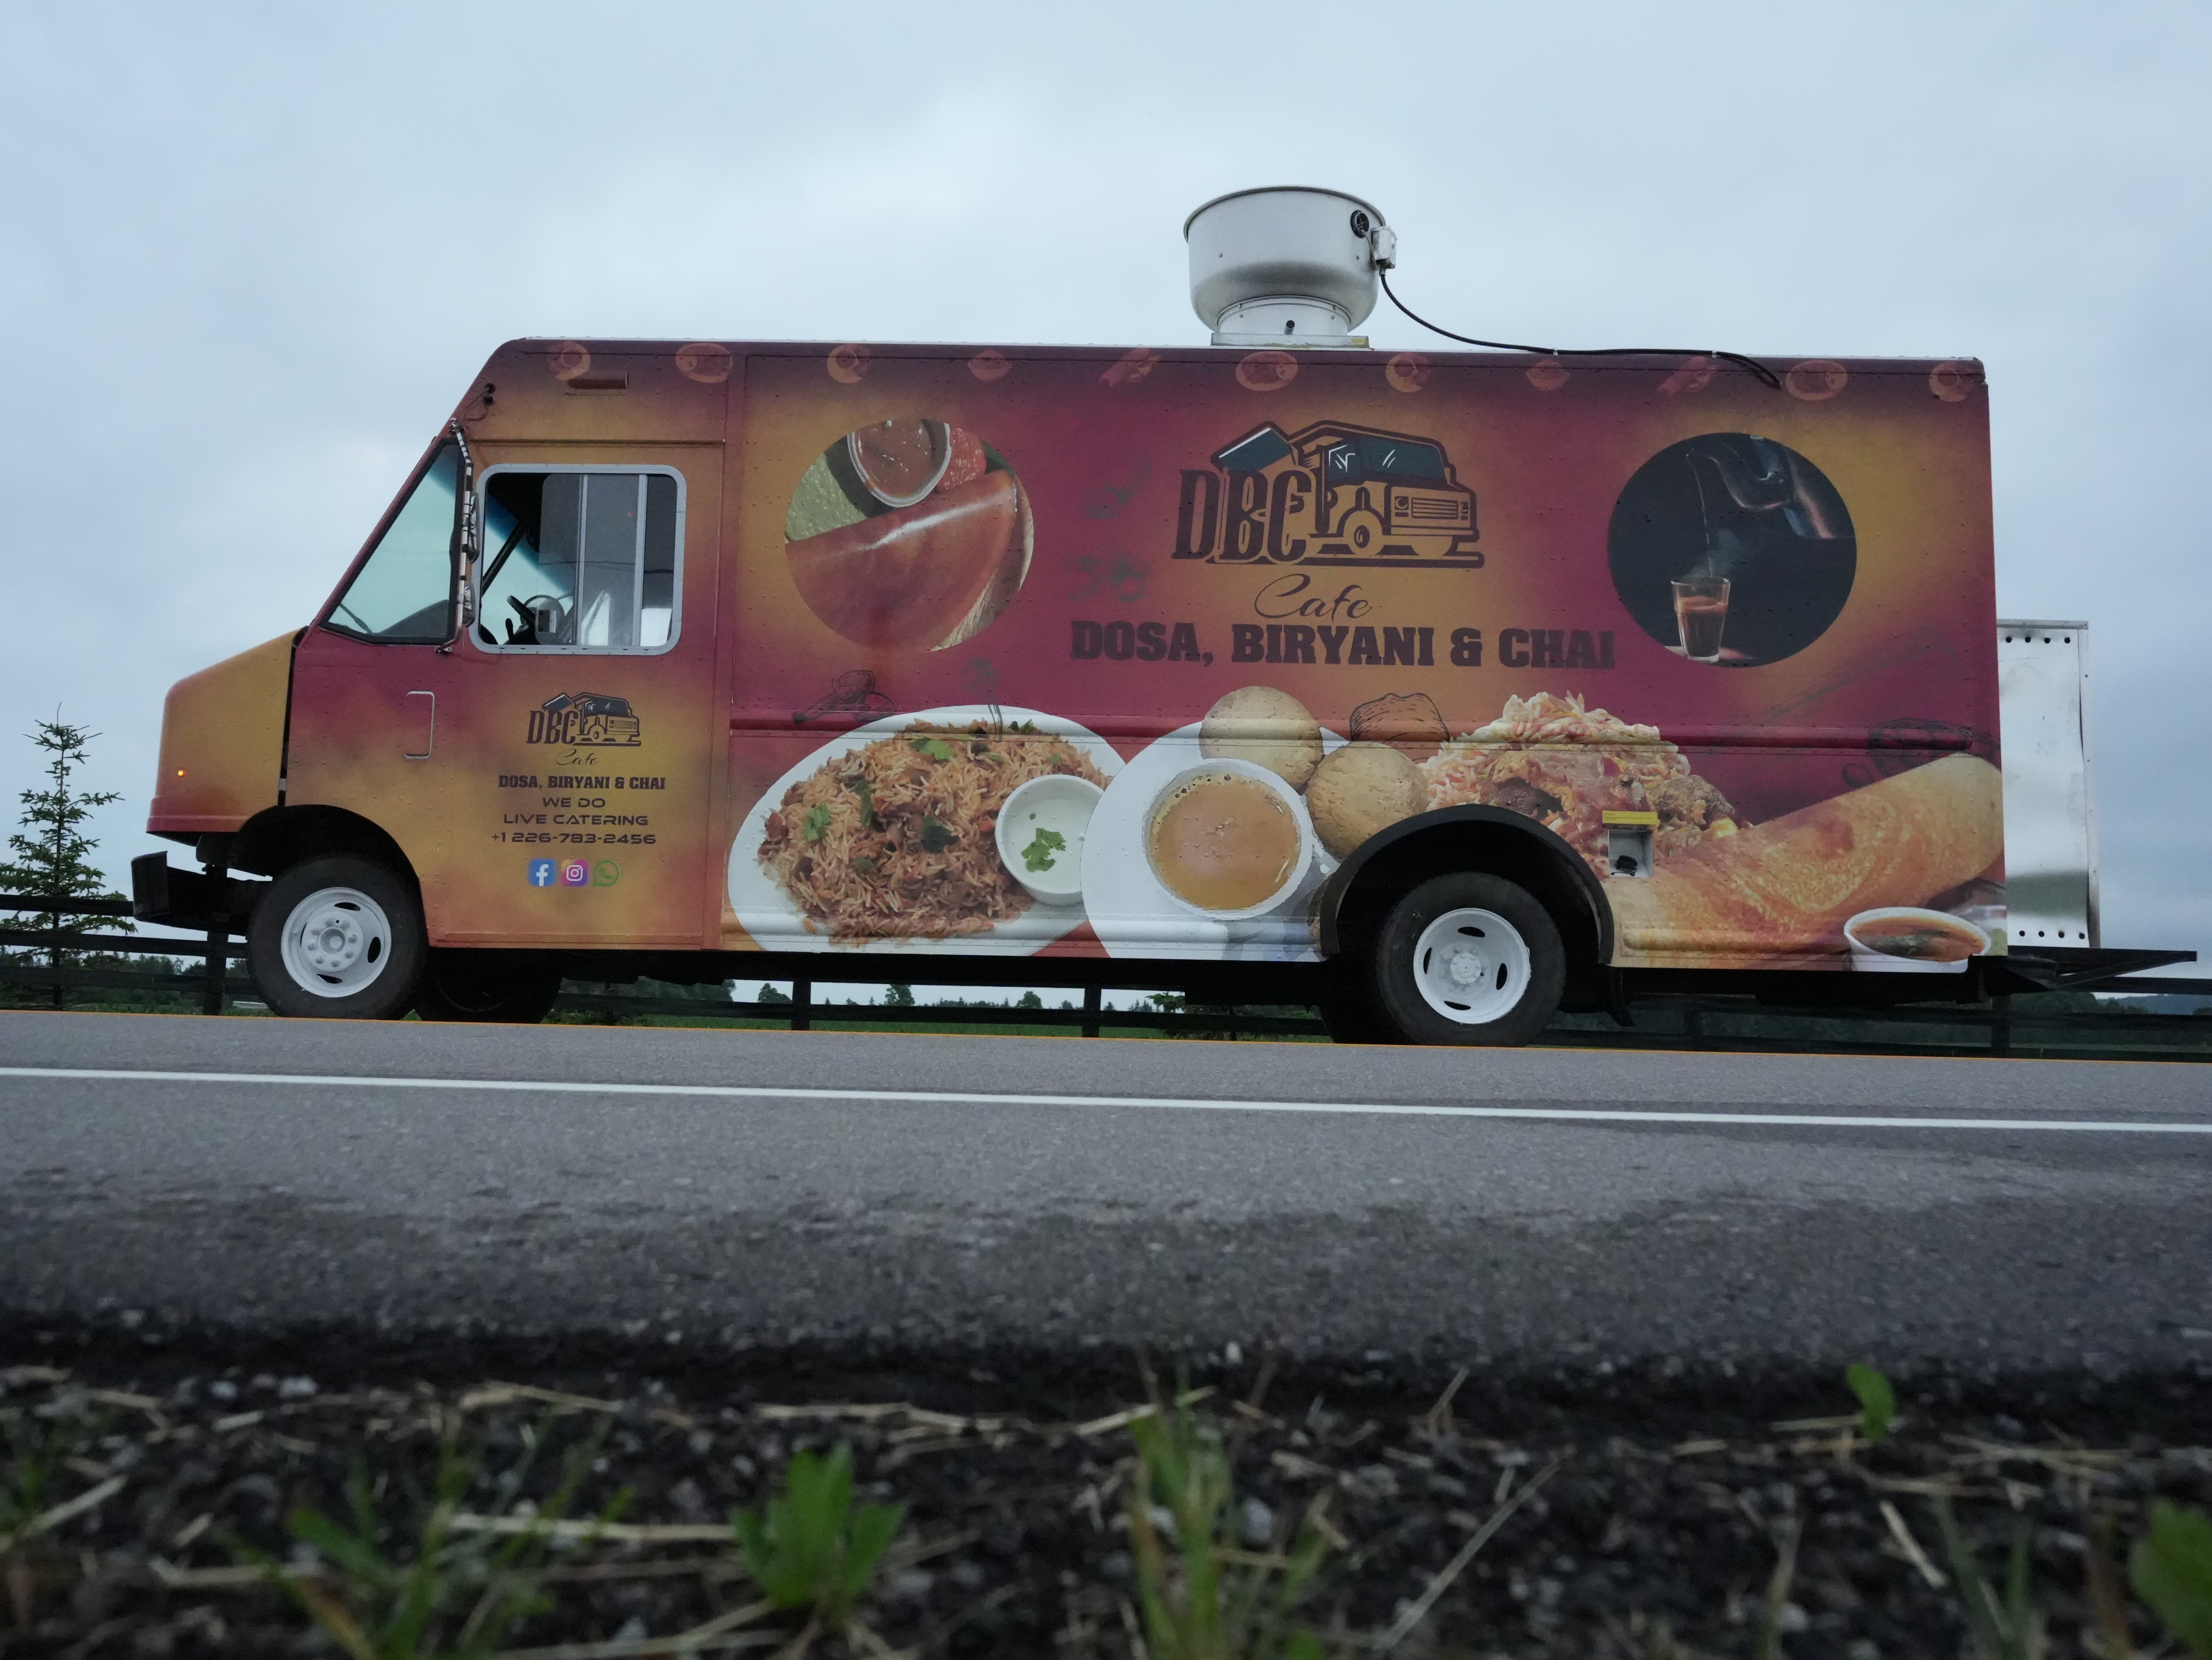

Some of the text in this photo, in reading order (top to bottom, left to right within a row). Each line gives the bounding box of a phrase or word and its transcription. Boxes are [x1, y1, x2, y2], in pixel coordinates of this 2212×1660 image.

[1171, 467, 1313, 565] DBC
[1255, 573, 1373, 622] Cafe
[1070, 620, 1615, 669] DOSA, BIRYANI & CHAI
[526, 710, 579, 745] DBC
[556, 748, 597, 765] Cafe
[499, 775, 665, 790] DOSA, BIRYANI & CHAI
[542, 798, 605, 808] WE DO
[504, 814, 648, 825] LIVE CATERING
[492, 832, 656, 844] +1 226-783-2456
